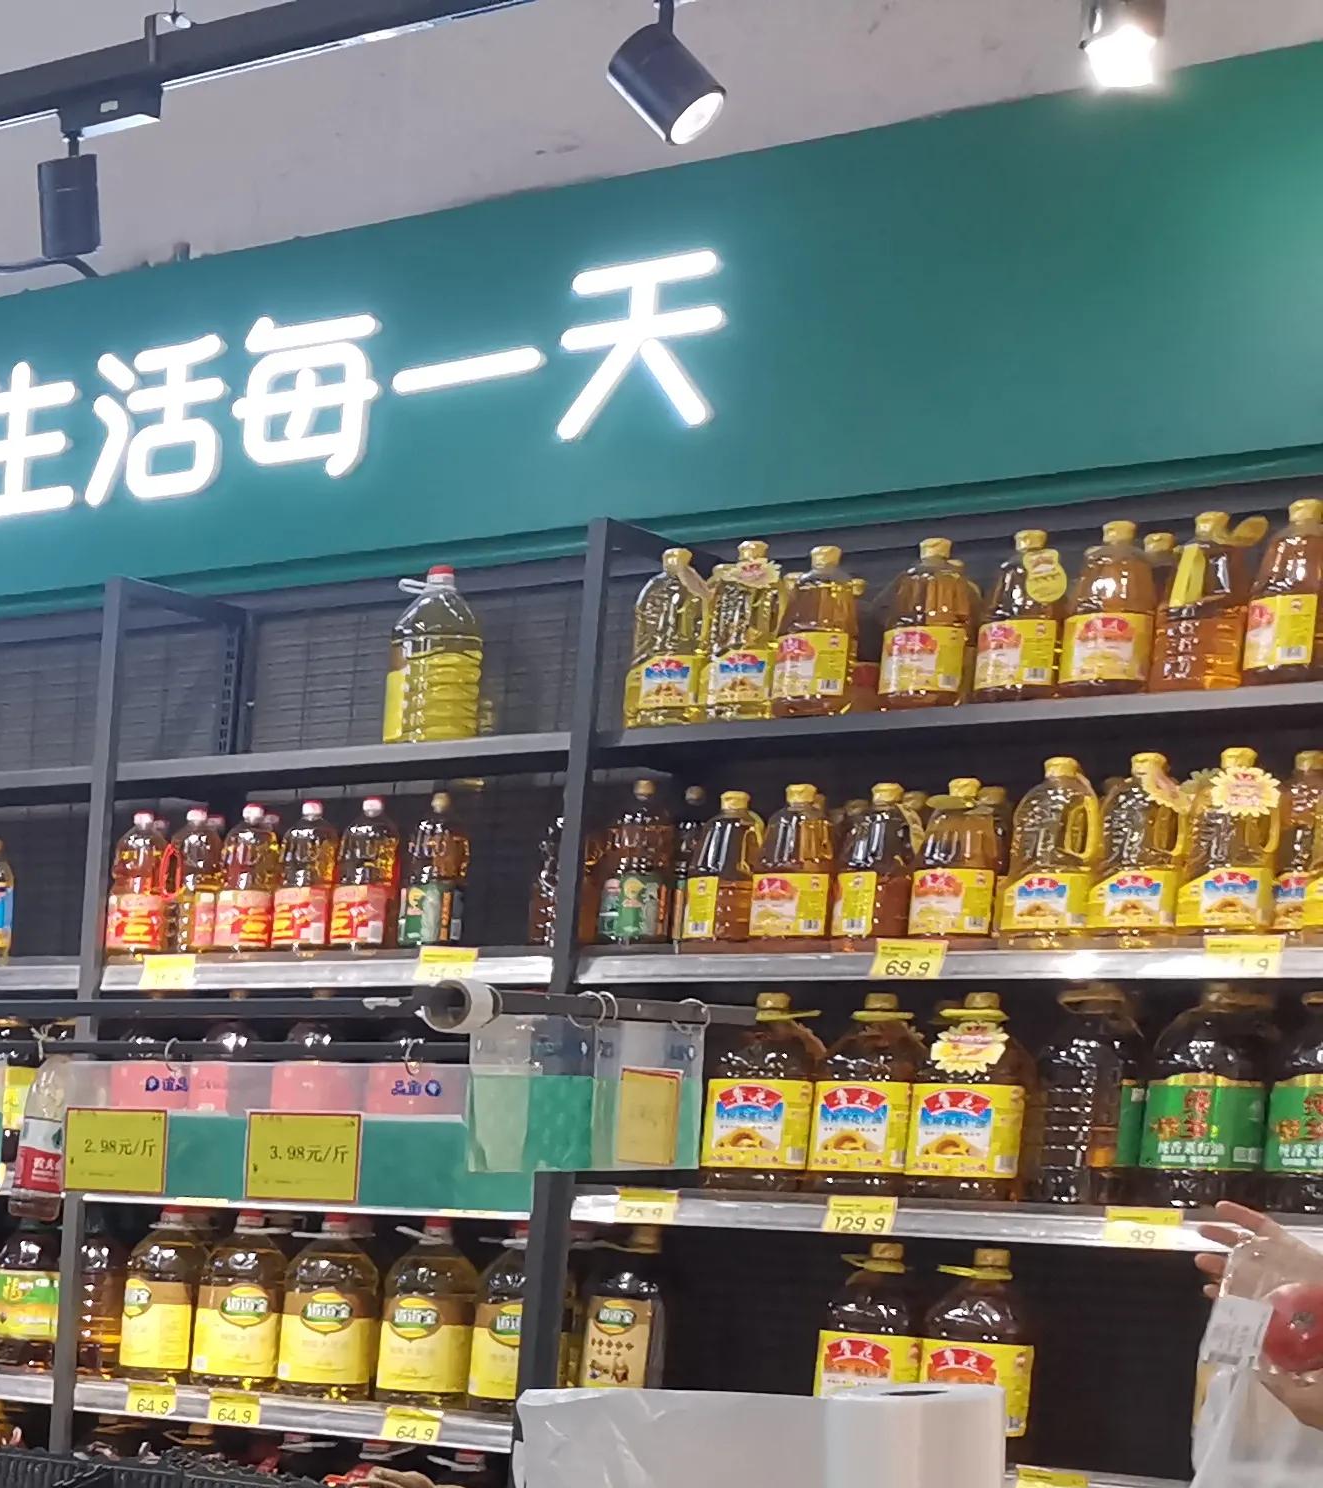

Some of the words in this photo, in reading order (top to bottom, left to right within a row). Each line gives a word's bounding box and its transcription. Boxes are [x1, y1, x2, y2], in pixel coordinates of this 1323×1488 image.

[884, 959, 931, 977] 69.9
[136, 1398, 170, 1415] 64.9
[217, 1408, 253, 1424] 64.9
[396, 1424, 434, 1442] 64.9
